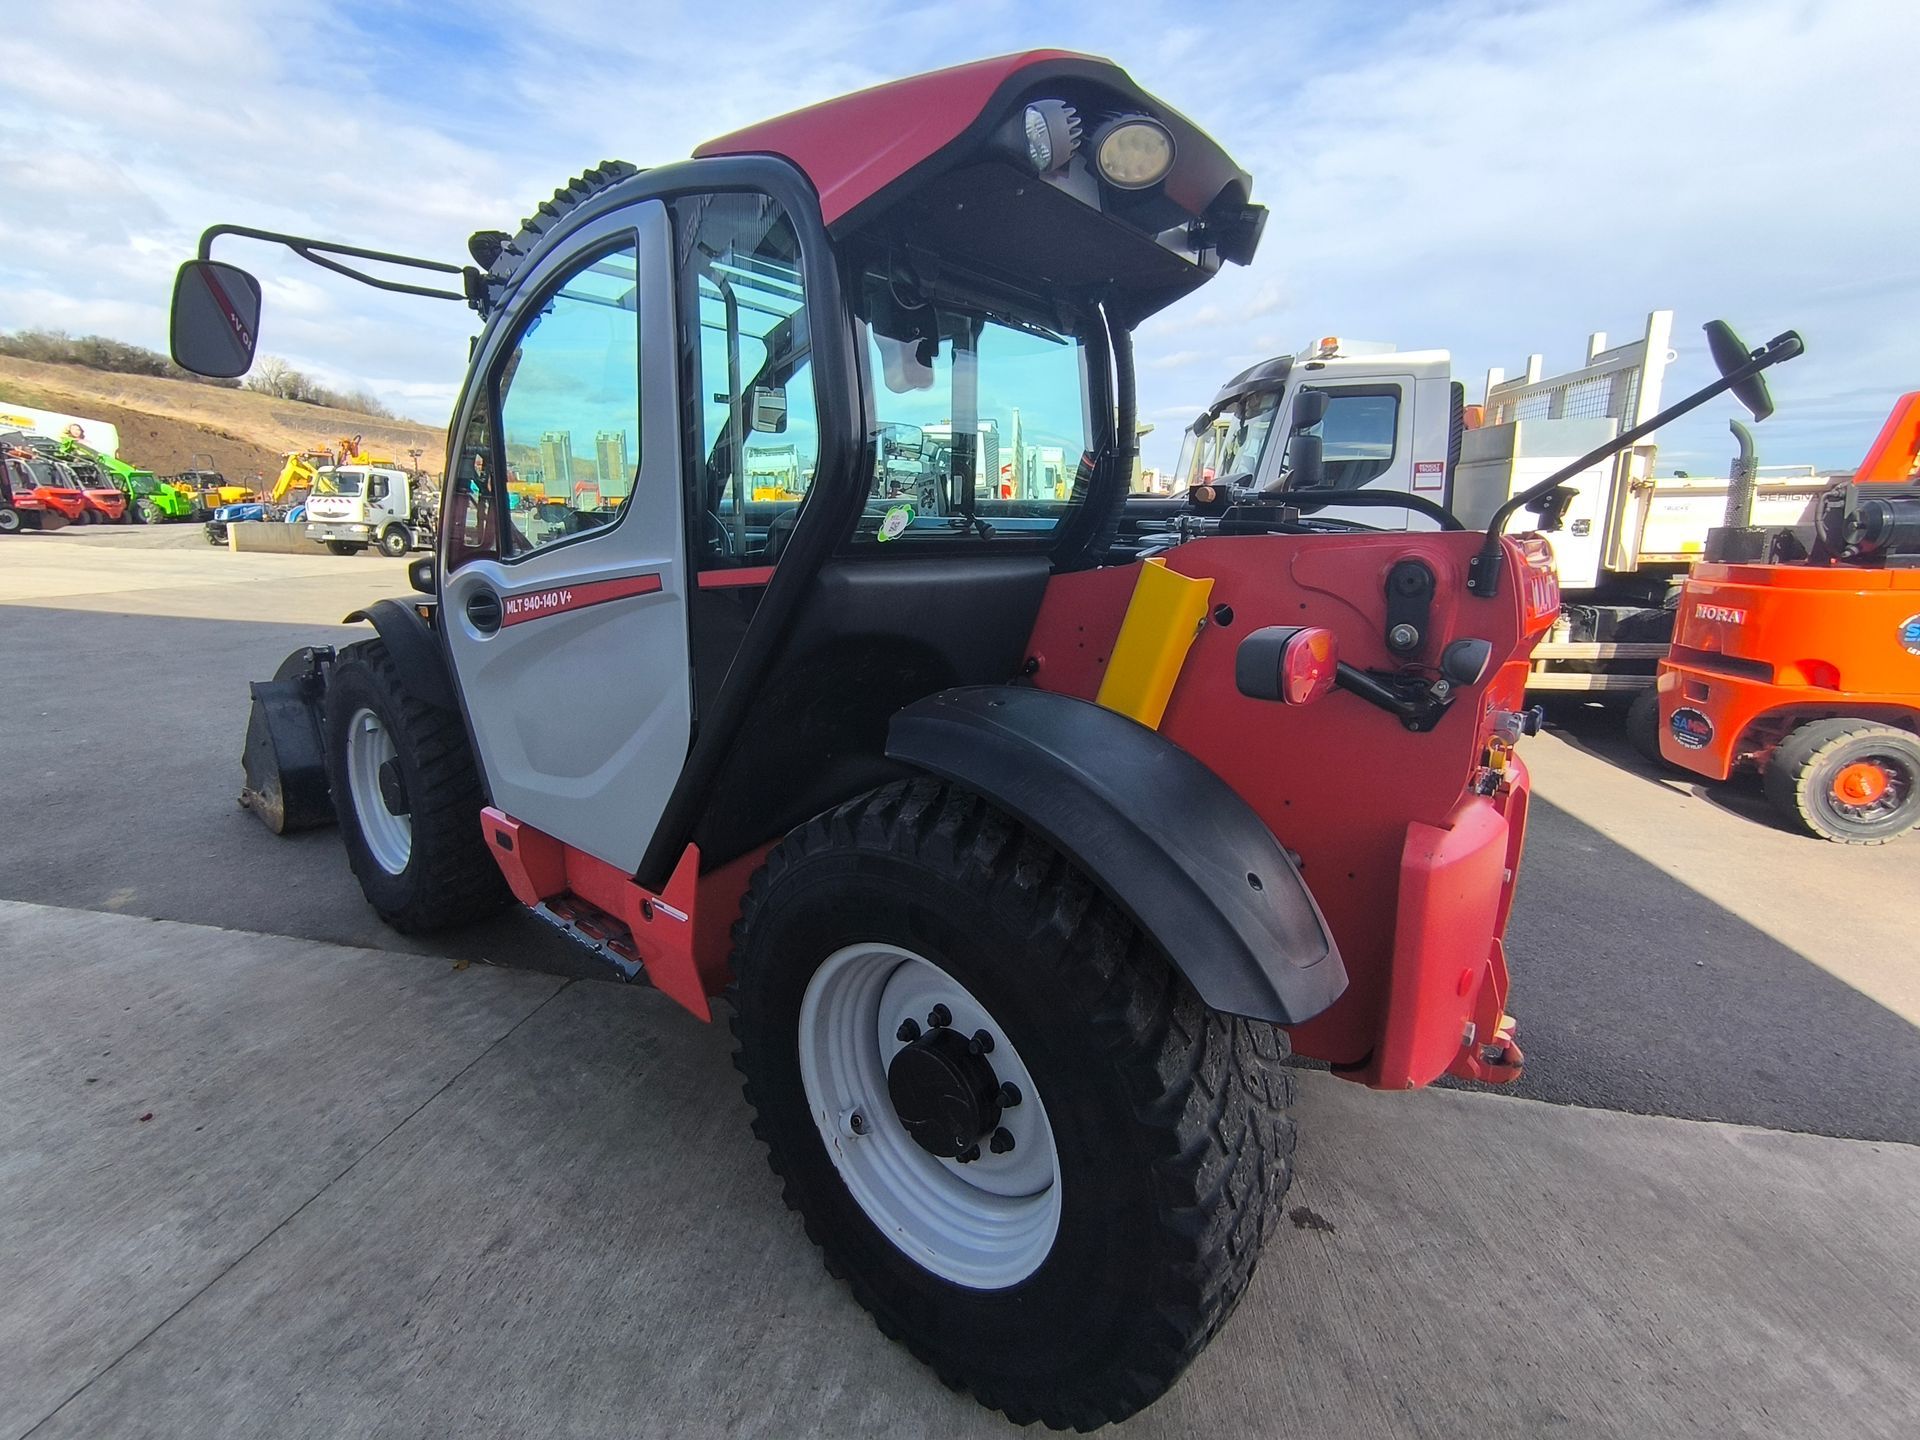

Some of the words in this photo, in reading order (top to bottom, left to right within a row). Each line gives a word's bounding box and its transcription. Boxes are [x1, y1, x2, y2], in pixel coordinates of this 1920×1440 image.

[506, 598, 523, 614] MLT
[523, 592, 558, 612] 940-140
[559, 590, 572, 605] V+
